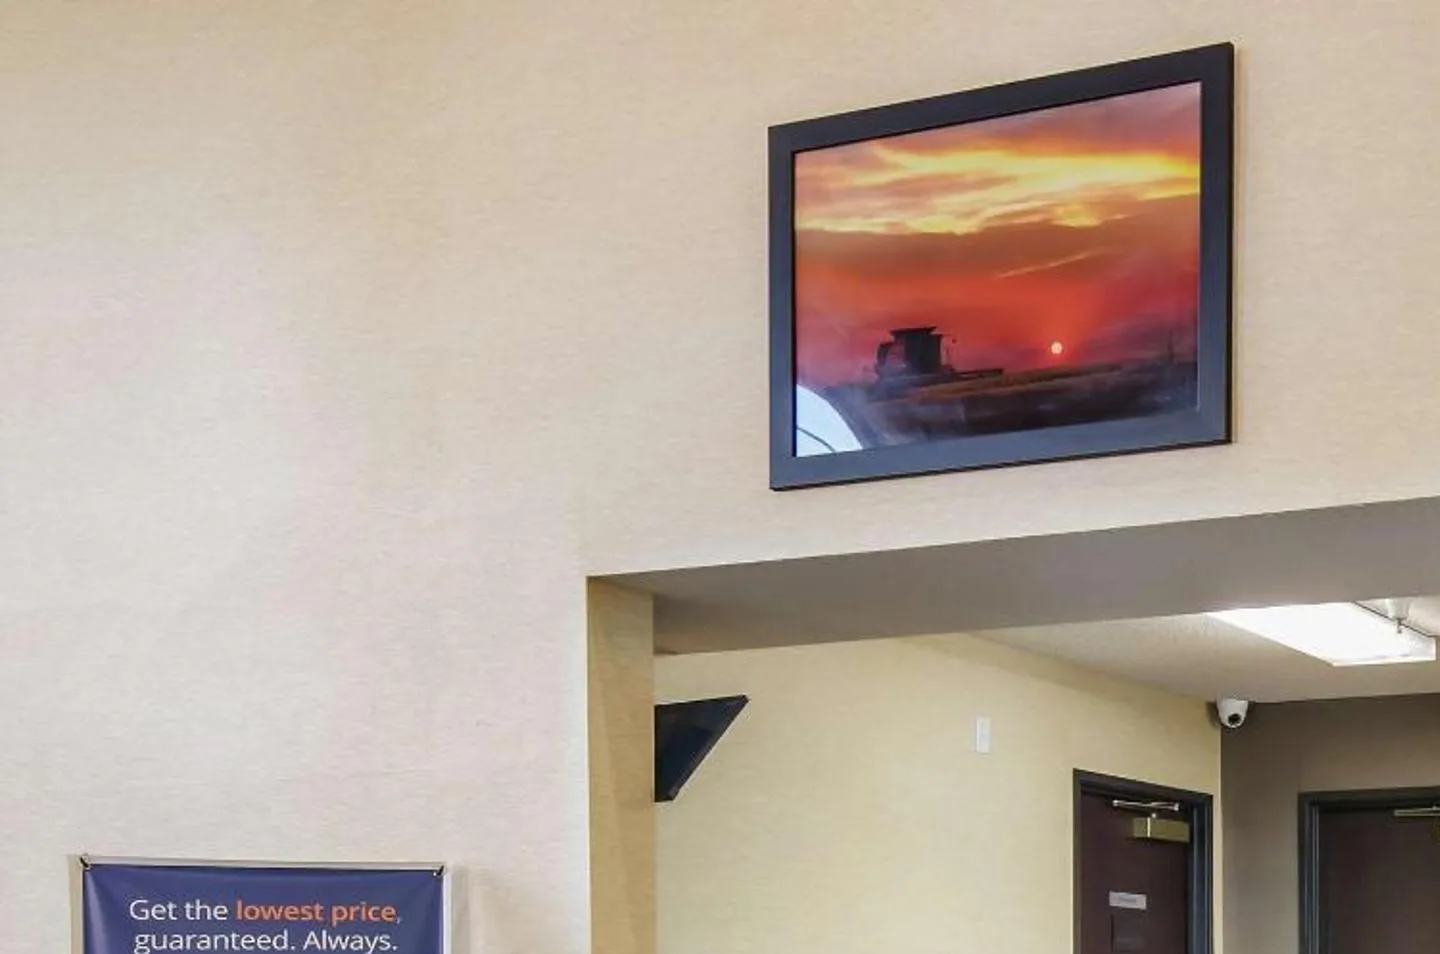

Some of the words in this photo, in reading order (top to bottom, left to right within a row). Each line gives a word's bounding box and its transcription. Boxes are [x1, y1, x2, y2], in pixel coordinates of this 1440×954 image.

[130, 899, 178, 921] Get
[184, 898, 228, 920] the
[236, 899, 324, 921] lowest
[331, 901, 401, 928] price,
